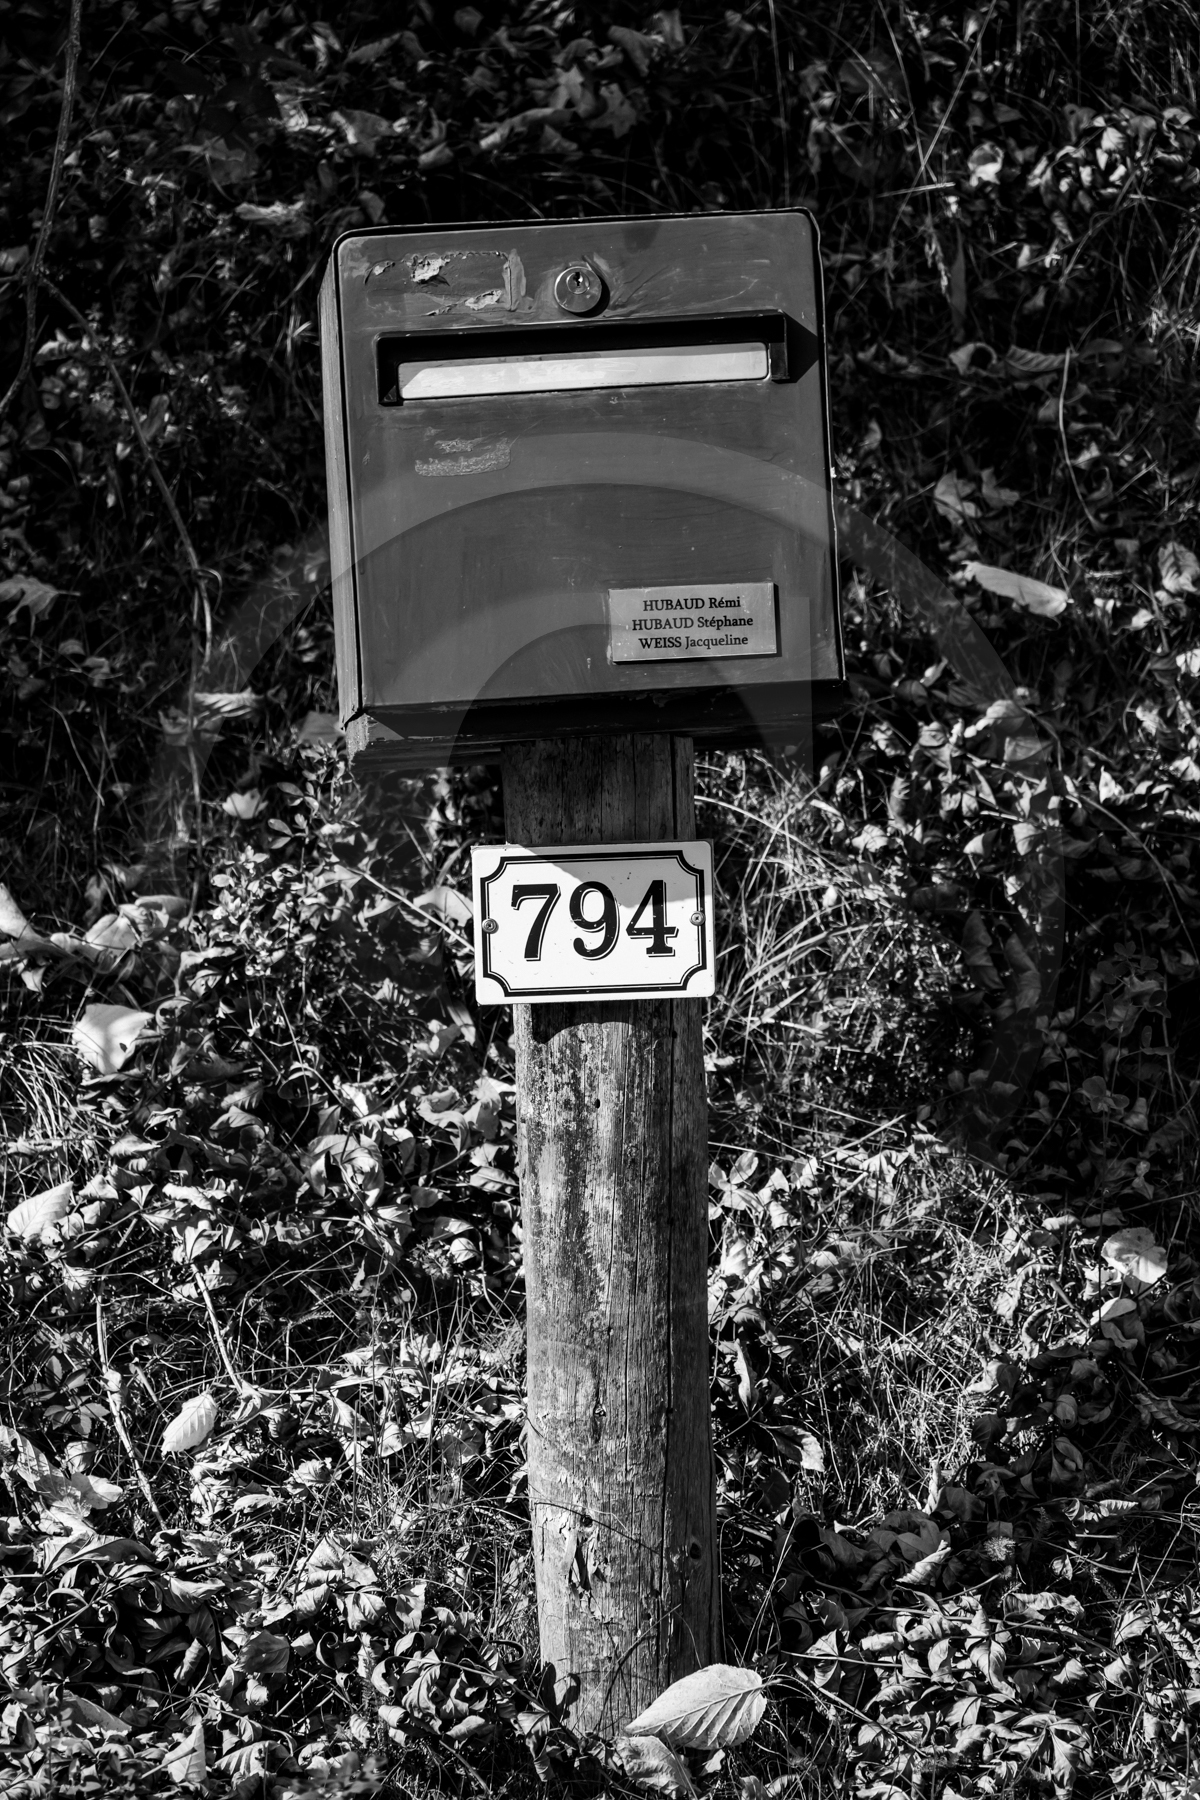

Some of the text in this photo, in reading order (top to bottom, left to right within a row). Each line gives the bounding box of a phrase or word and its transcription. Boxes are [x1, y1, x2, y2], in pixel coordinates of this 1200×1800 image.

[643, 596, 741, 611] HUBAUD Rémi
[632, 615, 754, 631] HUBAUD Stéphane
[639, 634, 749, 650] WEISS Jacqueline
[511, 879, 679, 961] 794
